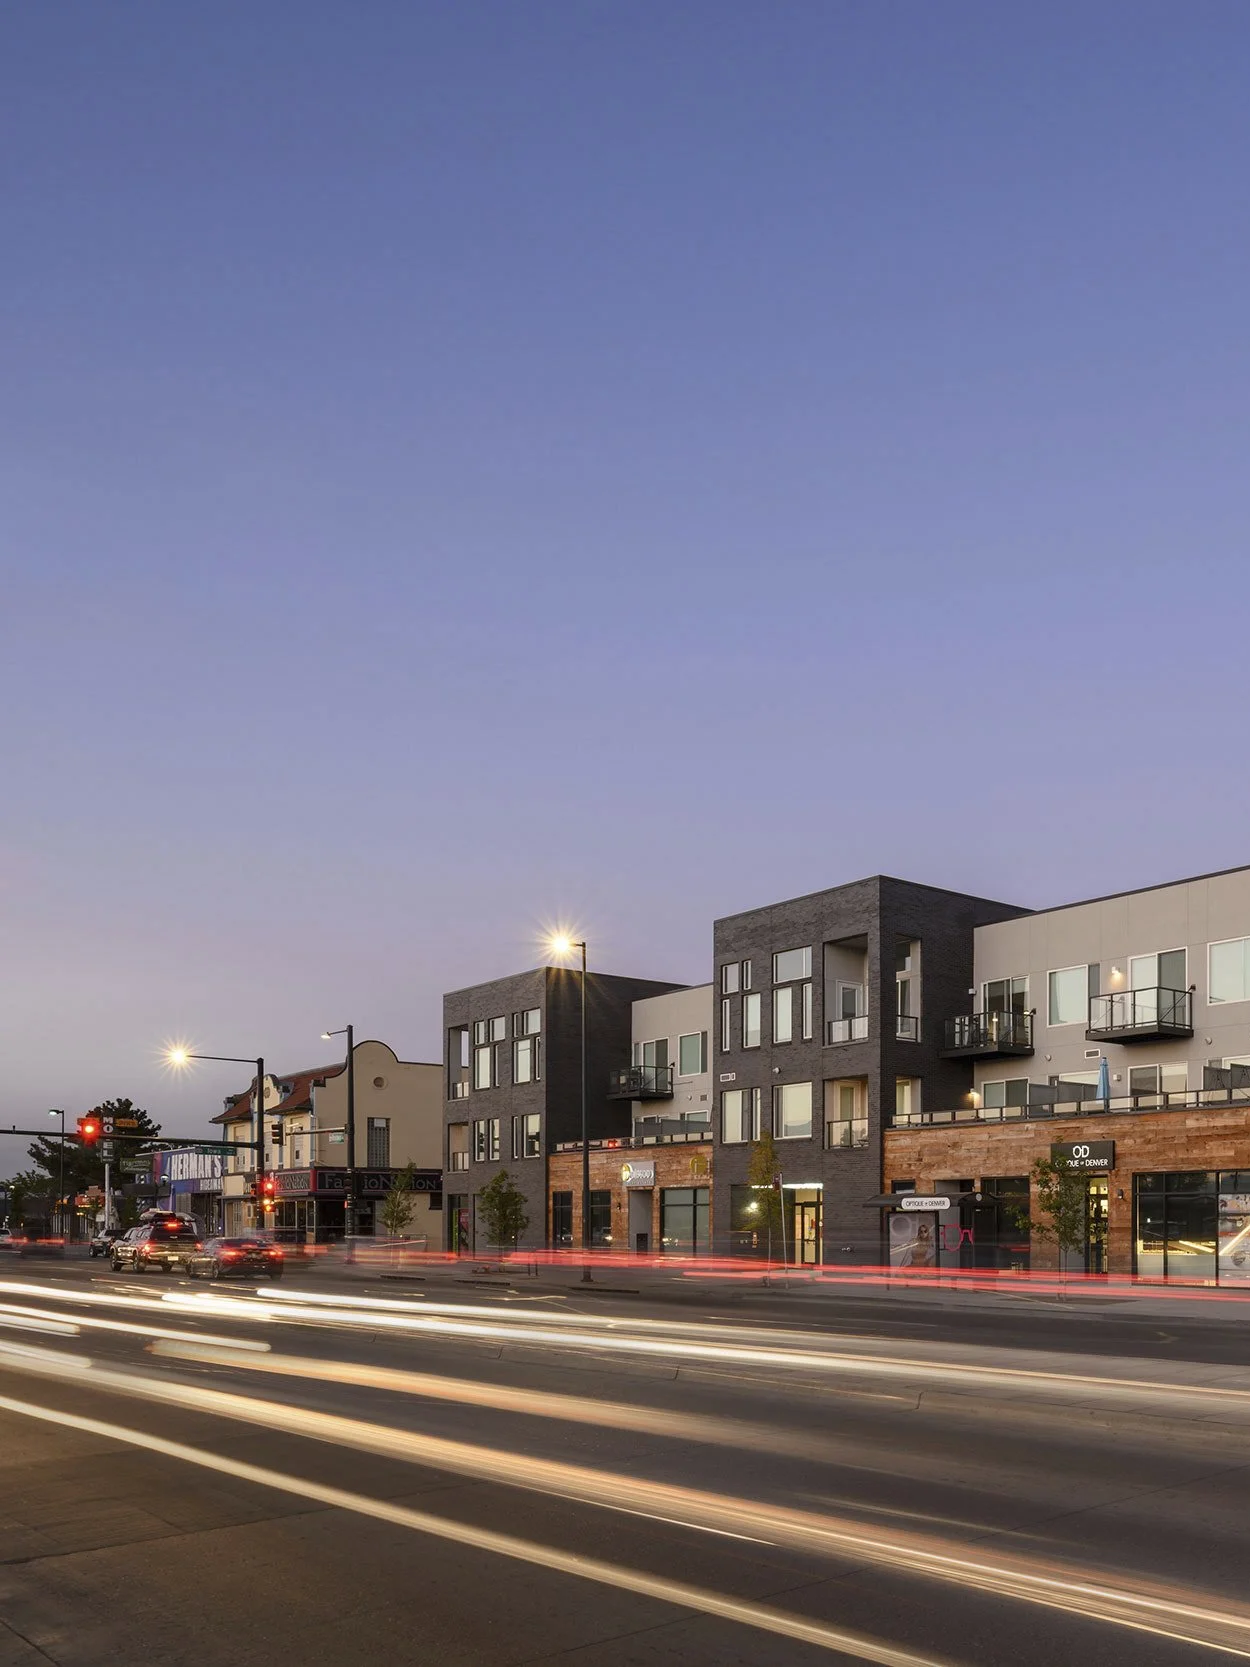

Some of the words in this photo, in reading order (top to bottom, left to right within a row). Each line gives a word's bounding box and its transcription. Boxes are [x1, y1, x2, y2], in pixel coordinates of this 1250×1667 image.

[102, 1116, 113, 1157] MOEL
[1072, 1145, 1090, 1158] OD
[171, 1153, 222, 1181] HERMAN'S
[1085, 1158, 1109, 1167] DENVER
